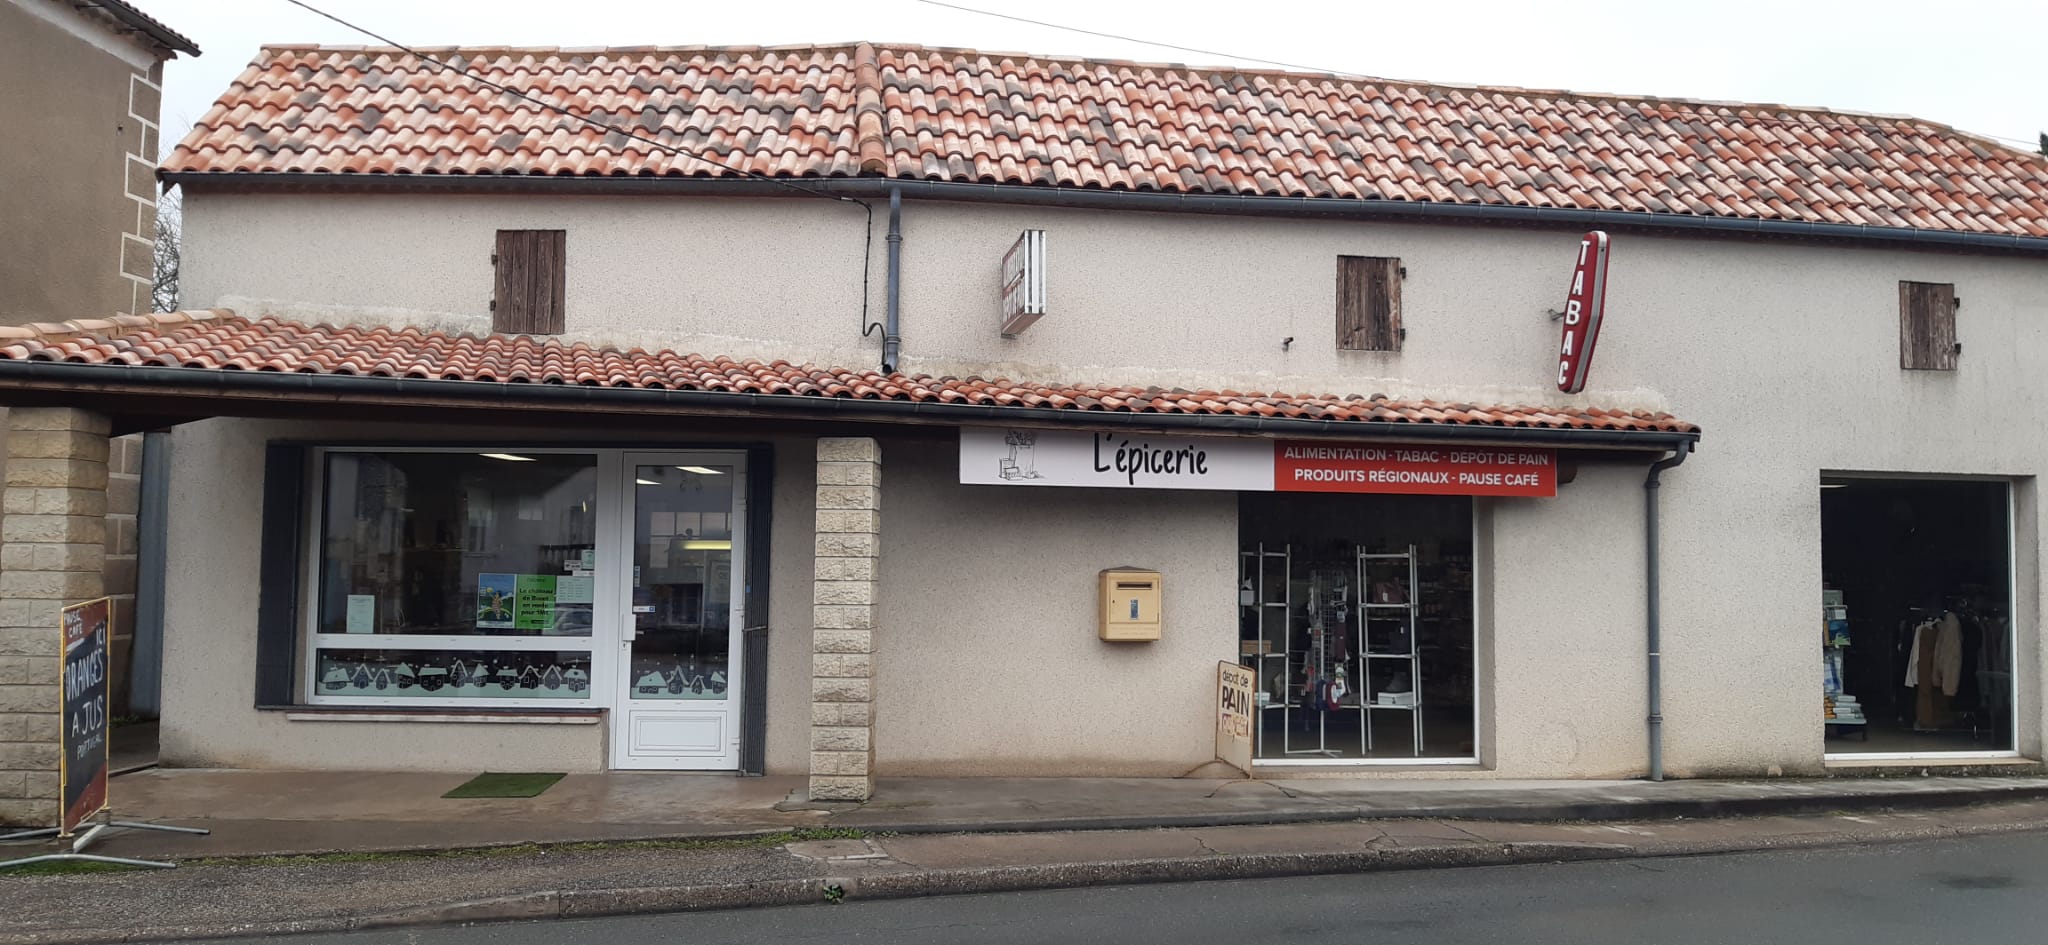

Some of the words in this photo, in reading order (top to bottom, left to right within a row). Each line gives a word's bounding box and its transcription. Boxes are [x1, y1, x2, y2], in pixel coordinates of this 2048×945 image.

[1558, 240, 1591, 385] TABAC
[1094, 432, 1208, 485] L'épicerie
[1284, 446, 1387, 460] ALIMENTATION
[1394, 449, 1440, 463] TABAC
[1498, 453, 1516, 465] DE
[1518, 453, 1548, 466] PAIN
[1294, 468, 1366, 482] PRODUITS
[1368, 467, 1449, 484] RÉGIONAUX
[1459, 472, 1502, 485] PAUSE
[1504, 471, 1539, 486] CAFÉ
[65, 648, 104, 702] ORANGES
[1240, 673, 1249, 688] de
[71, 711, 79, 738] A
[82, 694, 103, 735] JUS
[1222, 685, 1250, 717] PAIN
